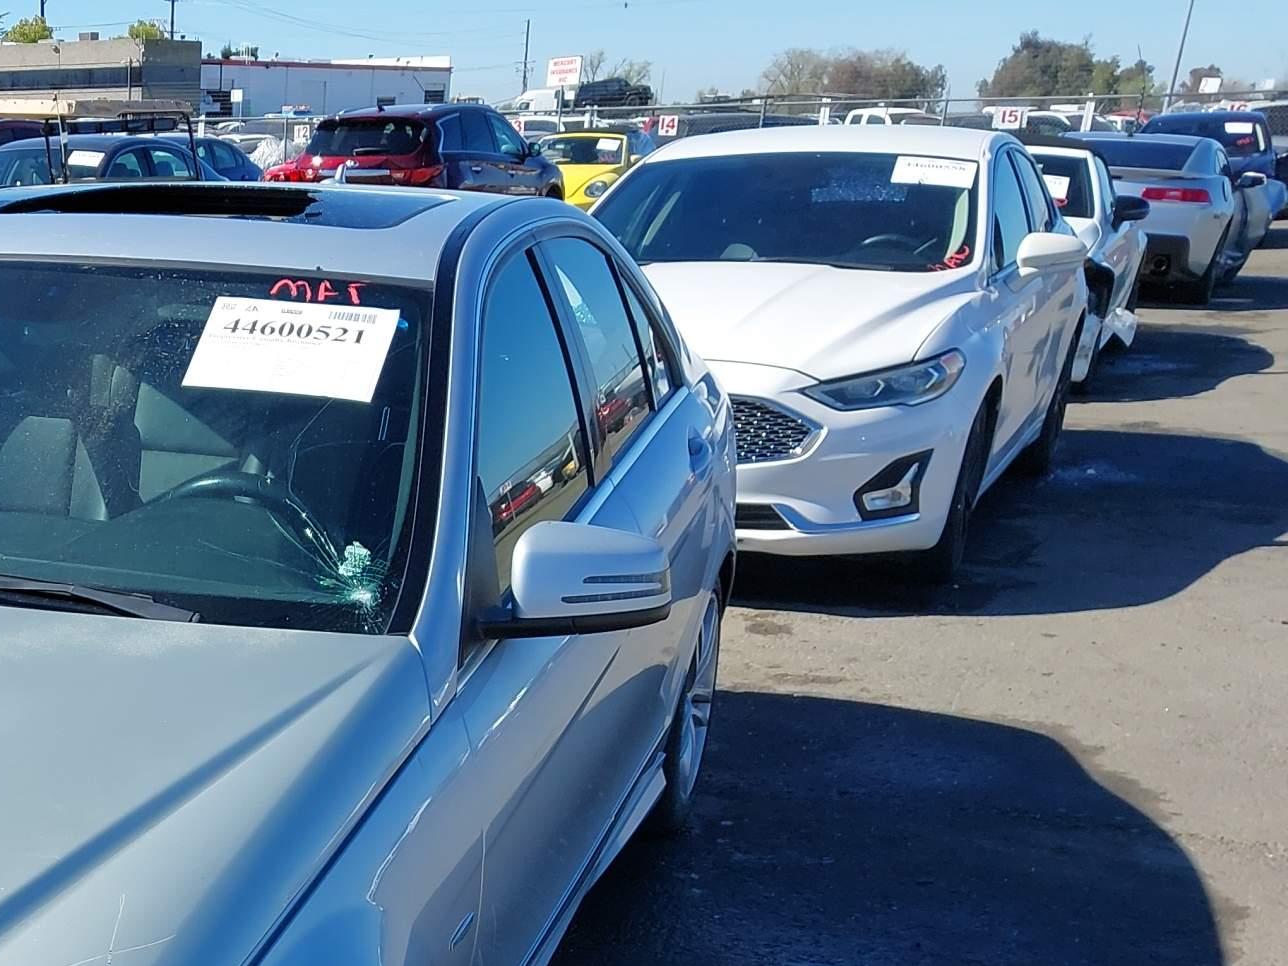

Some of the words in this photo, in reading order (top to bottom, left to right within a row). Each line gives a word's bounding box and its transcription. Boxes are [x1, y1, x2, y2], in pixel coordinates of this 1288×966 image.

[1001, 110, 1018, 123] 15
[661, 117, 675, 130] 14
[296, 126, 308, 138] 12
[223, 318, 365, 344] 44600521
